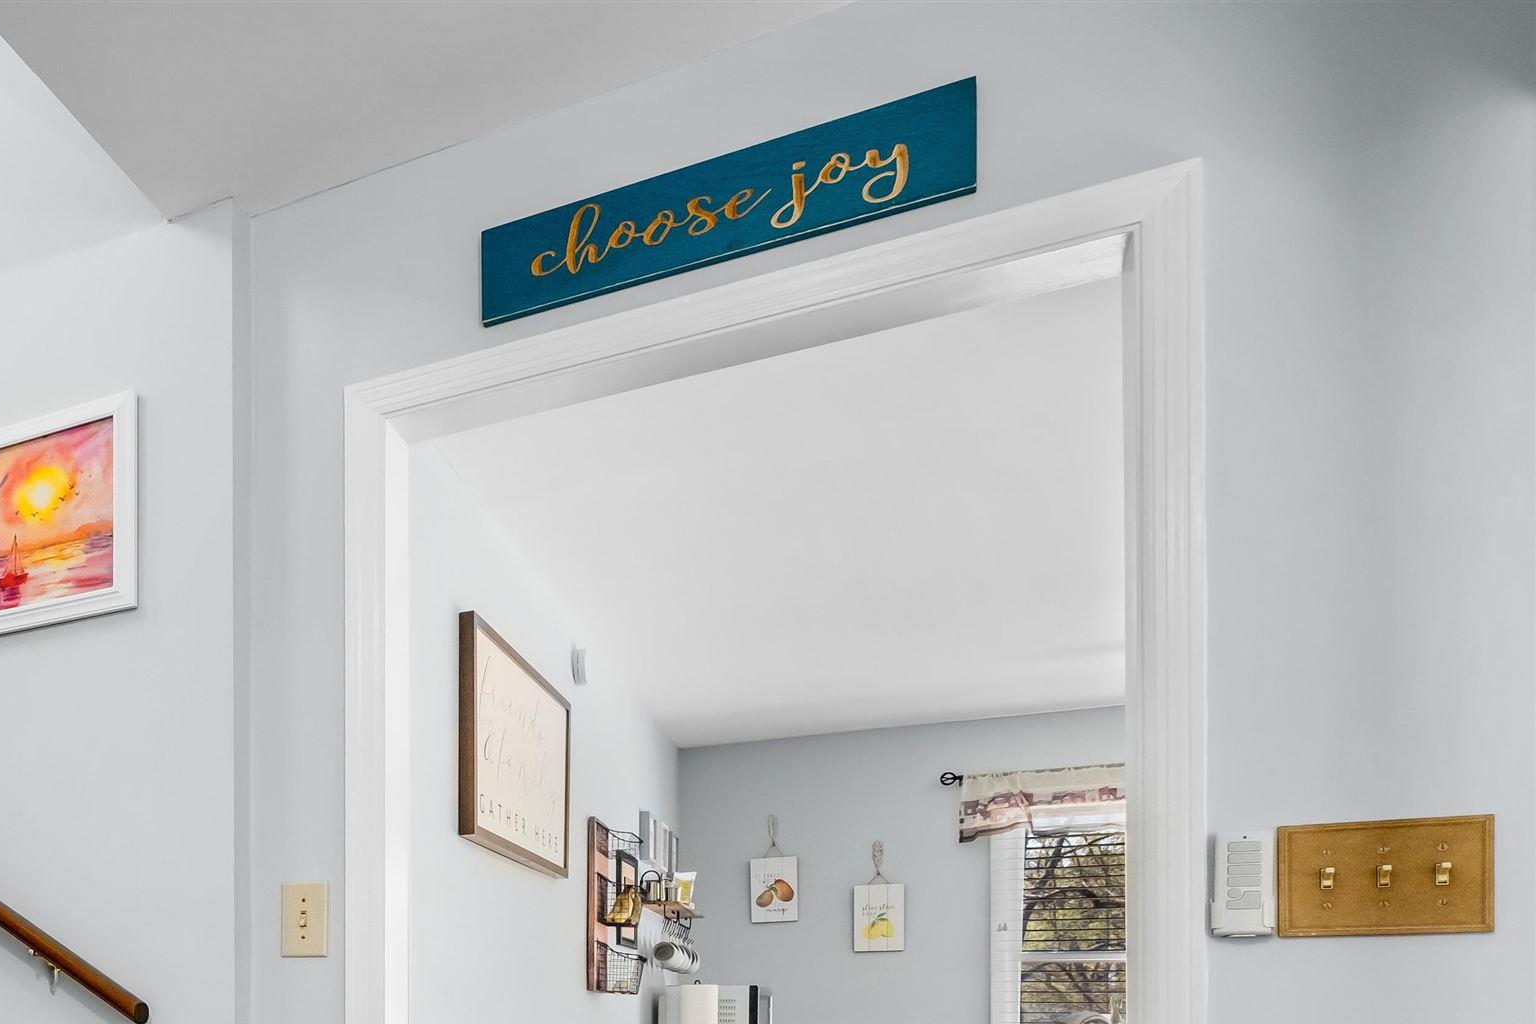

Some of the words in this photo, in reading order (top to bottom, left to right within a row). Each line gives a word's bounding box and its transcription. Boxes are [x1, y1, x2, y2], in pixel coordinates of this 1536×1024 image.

[531, 188, 772, 277] choose
[771, 143, 910, 229] joy
[479, 793, 527, 836] GATHER
[534, 826, 559, 854] HERE
